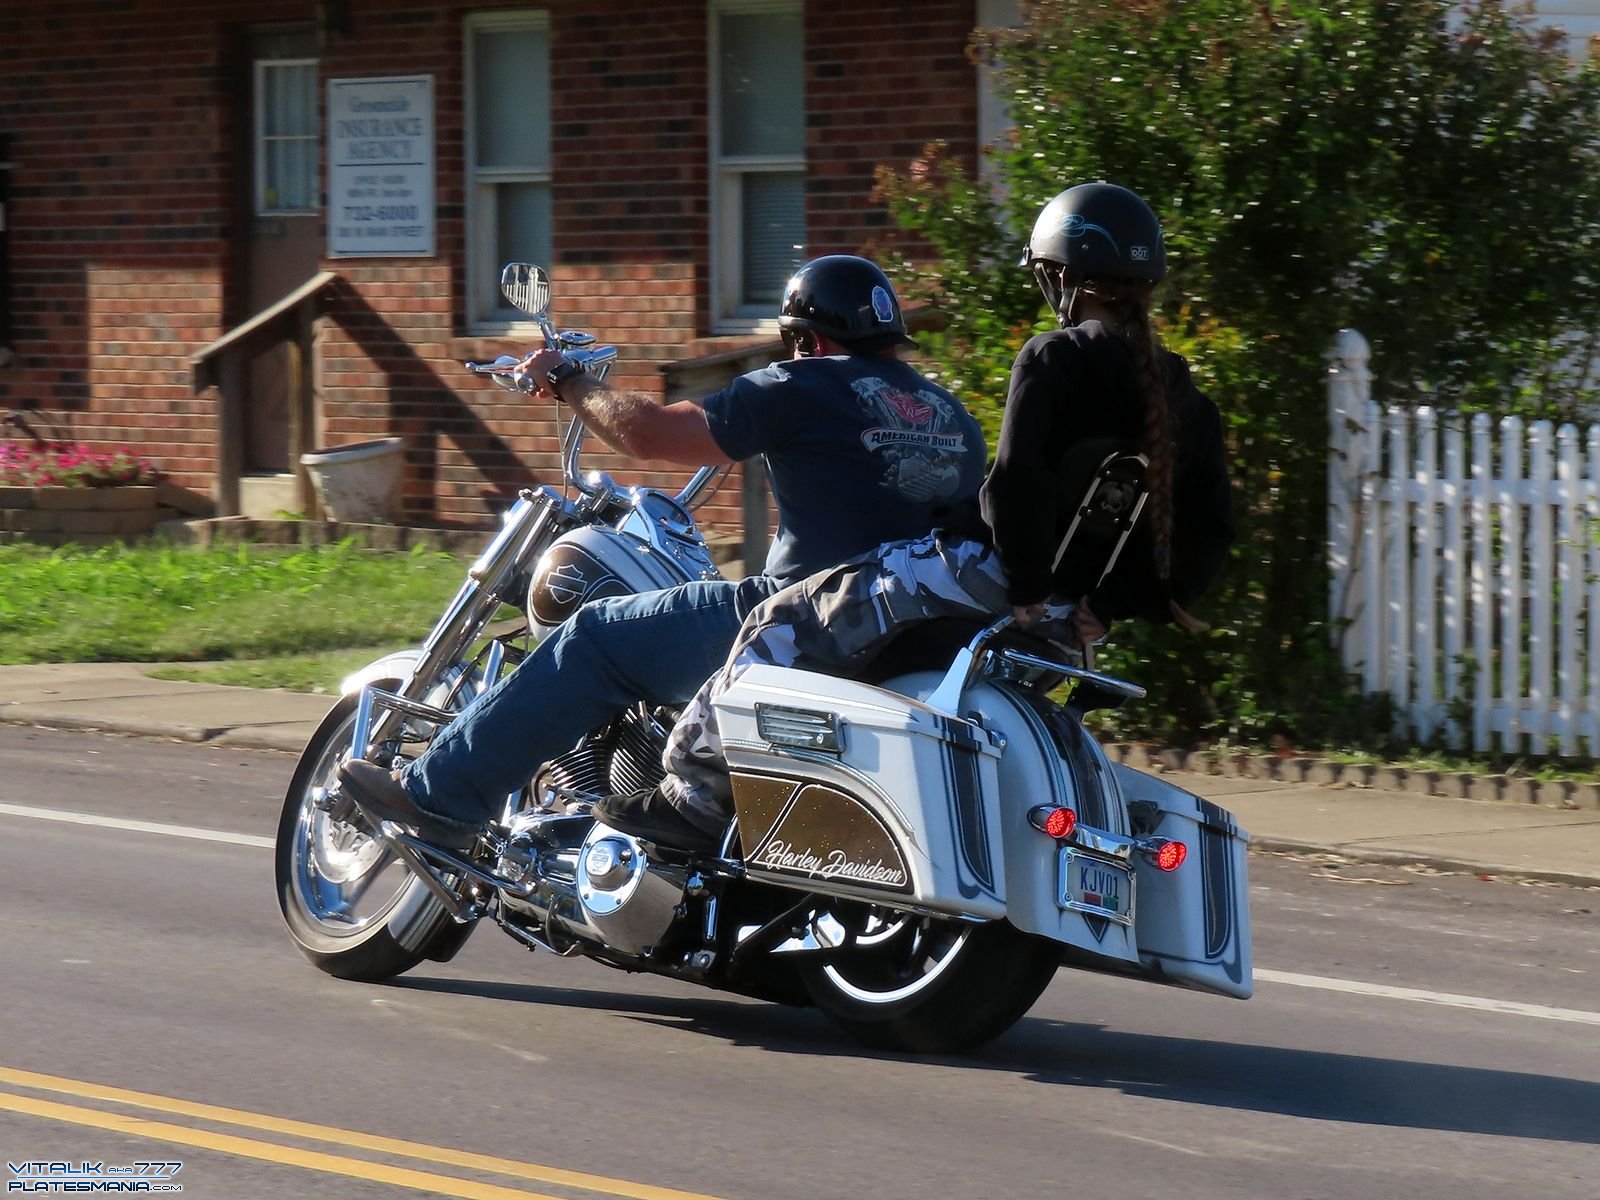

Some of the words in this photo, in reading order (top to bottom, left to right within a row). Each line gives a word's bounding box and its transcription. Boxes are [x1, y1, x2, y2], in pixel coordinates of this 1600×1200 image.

[335, 118, 423, 138] INSURANCE
[346, 140, 413, 159] AGENCY
[871, 431, 930, 444] AMERICAN
[931, 435, 958, 448] BUILT
[766, 840, 822, 880] Harley
[821, 850, 903, 883] Davidson
[1080, 866, 1119, 900] KJV01
